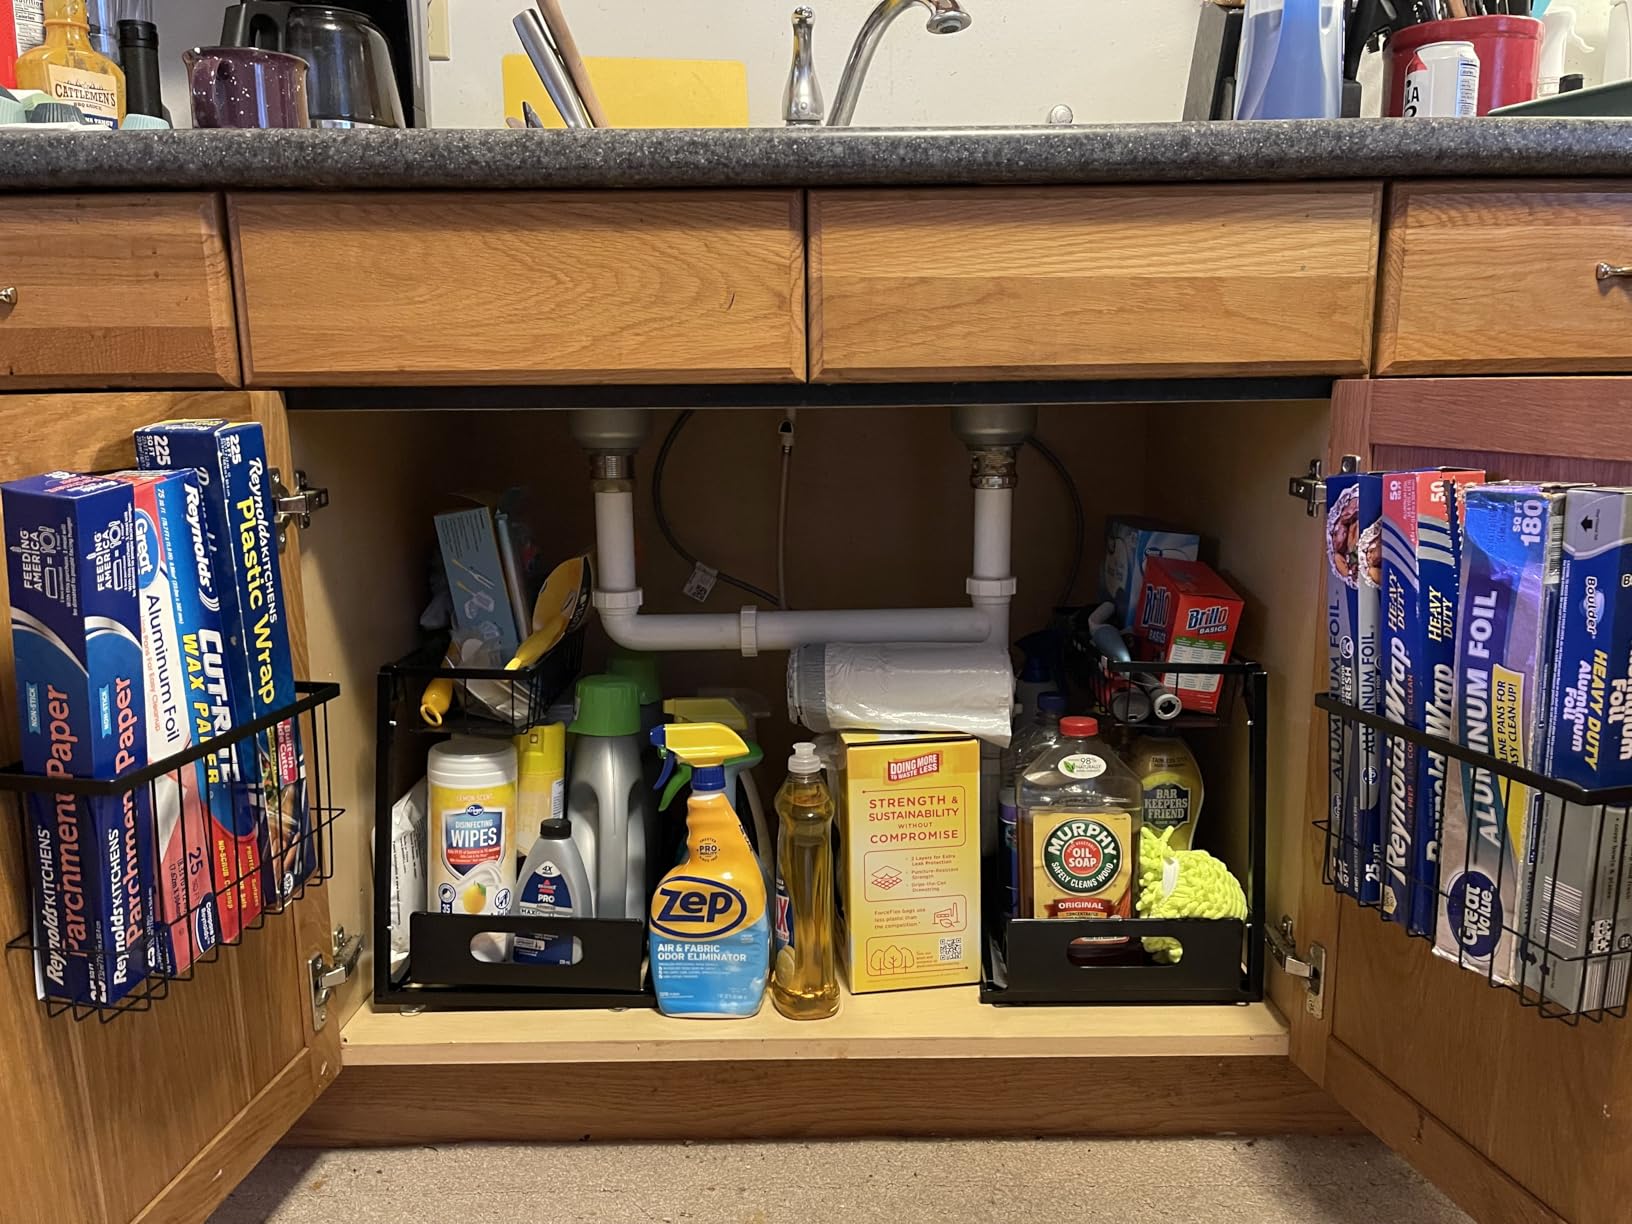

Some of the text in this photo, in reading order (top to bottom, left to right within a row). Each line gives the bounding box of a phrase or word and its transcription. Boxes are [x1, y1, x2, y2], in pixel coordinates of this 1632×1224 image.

[146, 436, 155, 457] SQ FT
[153, 435, 171, 466] 225
[229, 434, 242, 465] 225
[1389, 480, 1398, 500] 50
[1513, 500, 1522, 532] SQ FT
[1520, 499, 1543, 547] 180
[136, 518, 153, 576] Great
[184, 483, 212, 590] Reynolds
[20, 530, 33, 590] FEEDING
[29, 531, 43, 592] AMERICA
[94, 532, 104, 592] FEEDING
[101, 529, 112, 588] AMERICA
[236, 497, 263, 610] Plastic
[254, 613, 275, 705] Wrap
[1142, 584, 1171, 628] Brillo
[1186, 606, 1229, 630] Brillo
[1388, 569, 1399, 632] HEAVY
[1397, 585, 1405, 630] DUTY
[1428, 585, 1442, 642] HEAVY
[1442, 599, 1453, 639] DUTY
[1585, 575, 1597, 637] Boulder
[1199, 625, 1228, 635] BASICS
[1329, 601, 1341, 646] FOIL
[1467, 590, 1498, 659] FOIL
[146, 594, 172, 705] Aluminum
[163, 706, 180, 743] Foil
[182, 633, 206, 692] WAX
[1385, 637, 1411, 726] Wrap
[29, 686, 38, 728] NON-STICK
[198, 628, 240, 783] CUT-RTE
[1361, 632, 1375, 755] ALUINUM FOIL
[1425, 664, 1454, 741] Wrap
[1507, 683, 1519, 742] CLEAN-UP!
[1563, 687, 1577, 722] Foil
[1571, 659, 1592, 753] Aluminum
[1584, 648, 1608, 772] HEAVY DUTY
[1607, 678, 1627, 725] Foil
[46, 684, 78, 779] Paper
[1496, 681, 1508, 761] LINE PANS FOR
[278, 741, 289, 784] Cutter
[890, 754, 938, 775] DOING MORE
[898, 770, 918, 779] WASTE
[920, 763, 938, 774] LESS
[115, 677, 144, 948] Parchmen Paper
[869, 795, 959, 809] STRENGTH &
[1144, 798, 1188, 808] KEEPERS
[1156, 789, 1178, 799] BAR
[455, 818, 493, 829] DISINFECTING
[869, 808, 959, 821] SUSTAINABILITY
[1148, 808, 1185, 819] FRIEND
[451, 828, 498, 848] WIPES
[870, 830, 959, 844] COMPROMISE
[1047, 822, 1117, 855] MURPHY
[1072, 847, 1093, 858] OIL
[189, 847, 203, 876] 25
[217, 840, 230, 877] NO-SCRUB
[542, 865, 553, 873] 4X
[1051, 861, 1114, 889] SAFELY CLEANS WOOD
[1068, 857, 1097, 868] SOAP
[1365, 864, 1379, 882] 25
[203, 901, 217, 935] Compare
[441, 904, 451, 914] 35
[538, 894, 555, 904] PRO
[657, 888, 733, 923] Zep
[1058, 902, 1104, 911] ORIGINAL
[1462, 884, 1480, 947] Great
[1477, 889, 1493, 937] Value
[657, 943, 721, 953] AIR & FABRIC
[657, 952, 747, 962] ODOR ELIMINATOR
